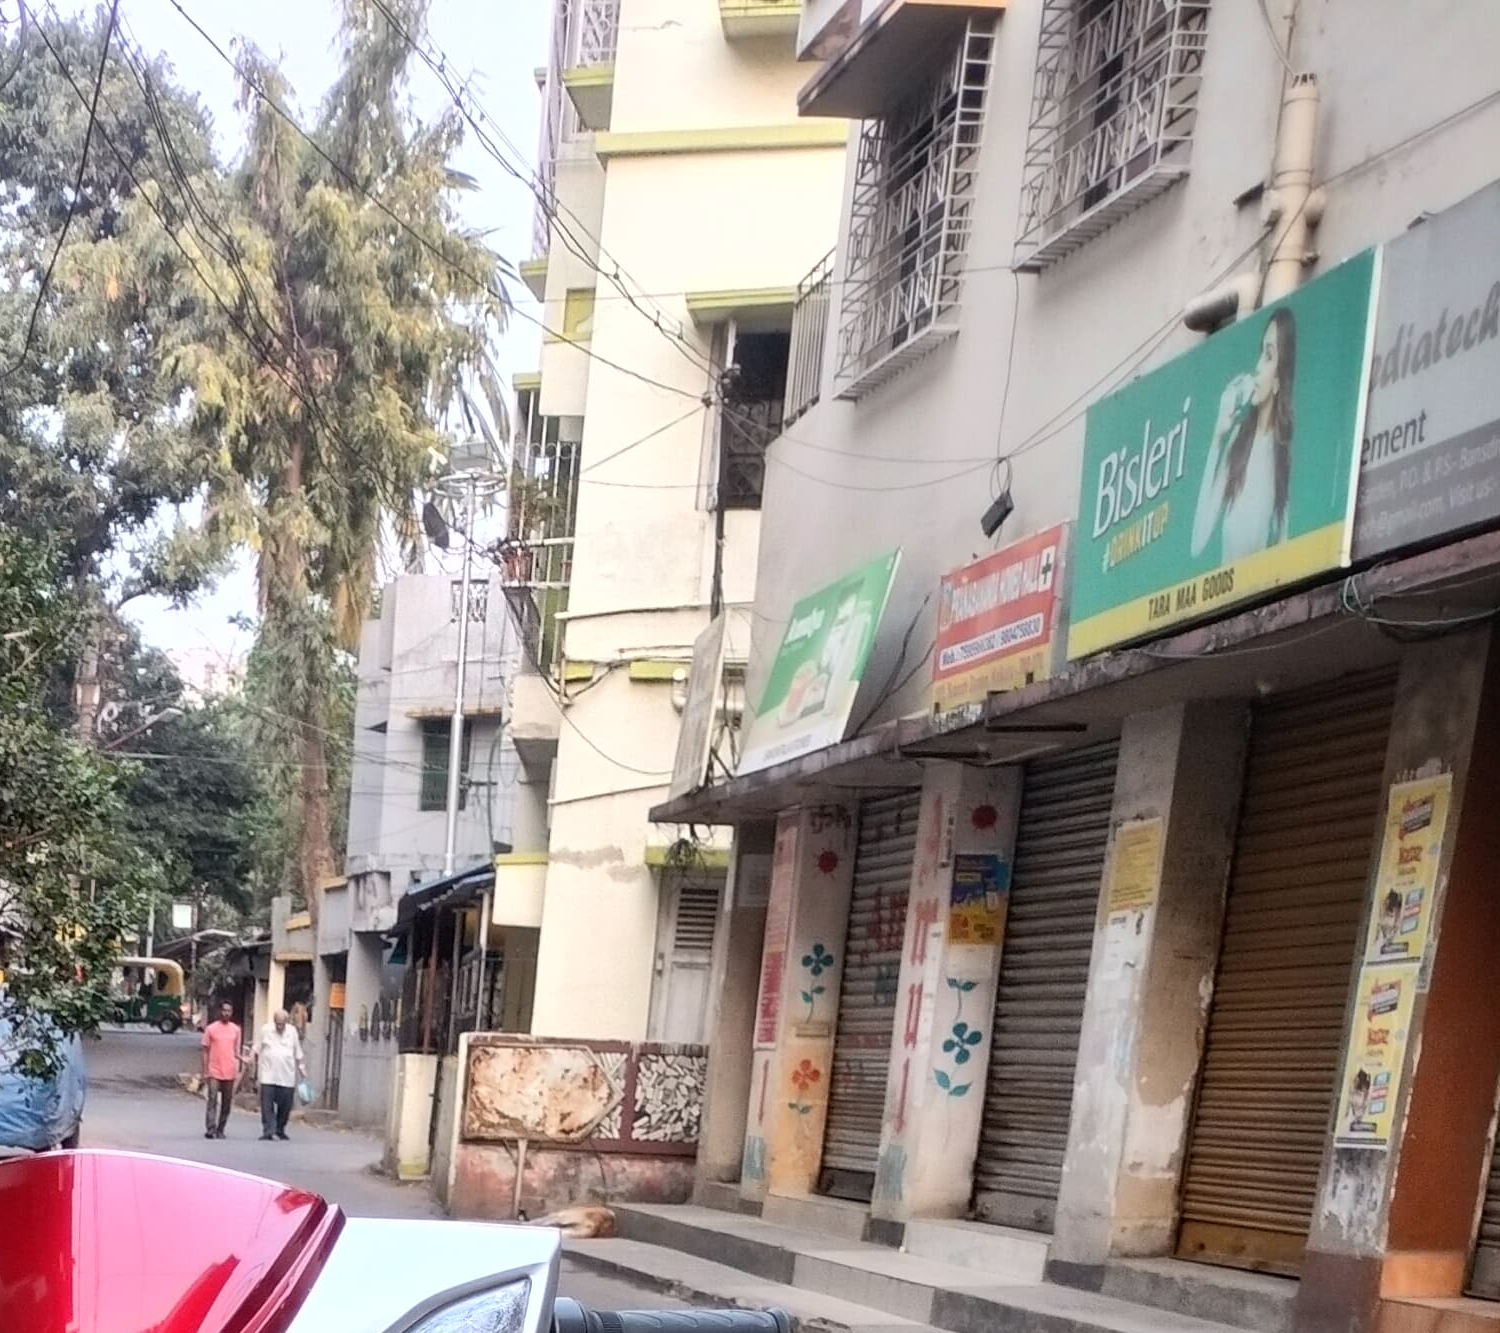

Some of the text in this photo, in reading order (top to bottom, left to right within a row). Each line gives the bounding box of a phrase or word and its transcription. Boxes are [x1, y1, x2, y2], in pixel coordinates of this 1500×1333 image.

[1093, 396, 1191, 539] Bisleri
[1148, 566, 1235, 622] TARA MAA GOODS
